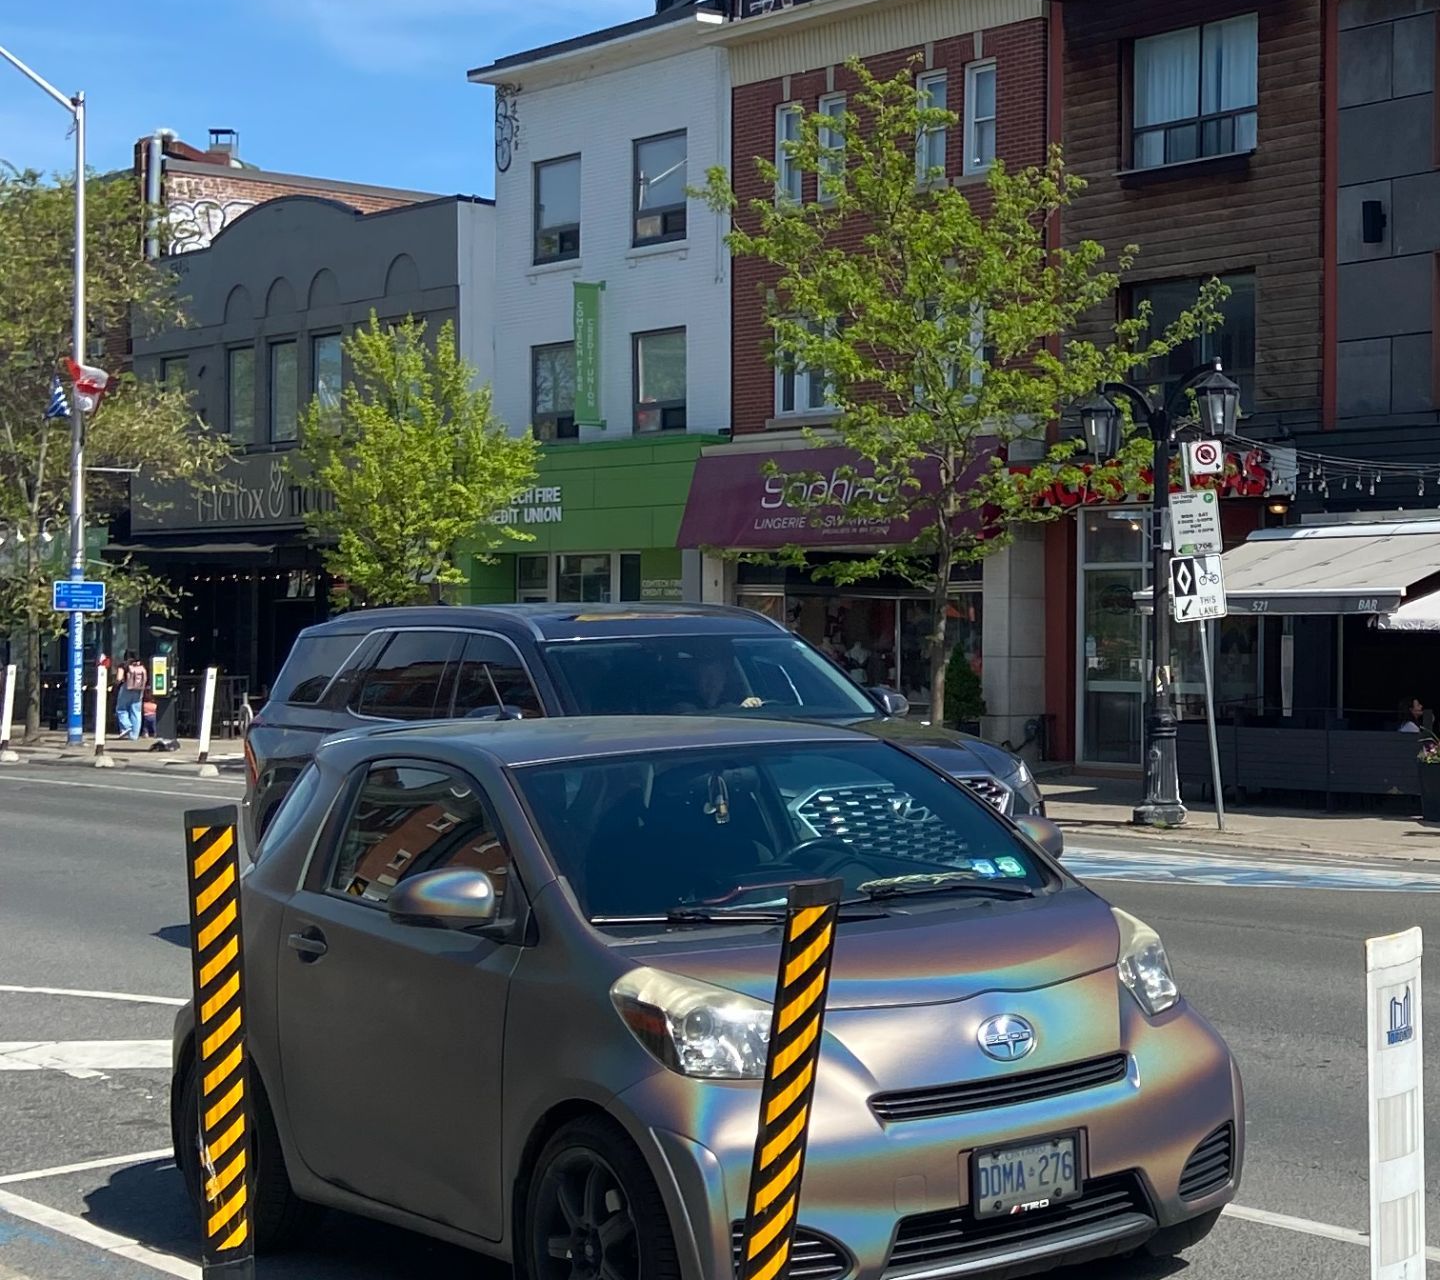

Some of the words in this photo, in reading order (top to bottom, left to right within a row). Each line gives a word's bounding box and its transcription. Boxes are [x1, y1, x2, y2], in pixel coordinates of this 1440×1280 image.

[535, 486, 562, 503] FIRE
[524, 506, 562, 523] UNION
[754, 517, 807, 530] LINGERIE
[1199, 596, 1216, 604] THIS
[1251, 601, 1269, 612] 521
[1357, 599, 1378, 610] BAR
[1199, 606, 1219, 615] LANE
[979, 1159, 1026, 1199] DDMA
[1038, 1150, 1073, 1187] 276
